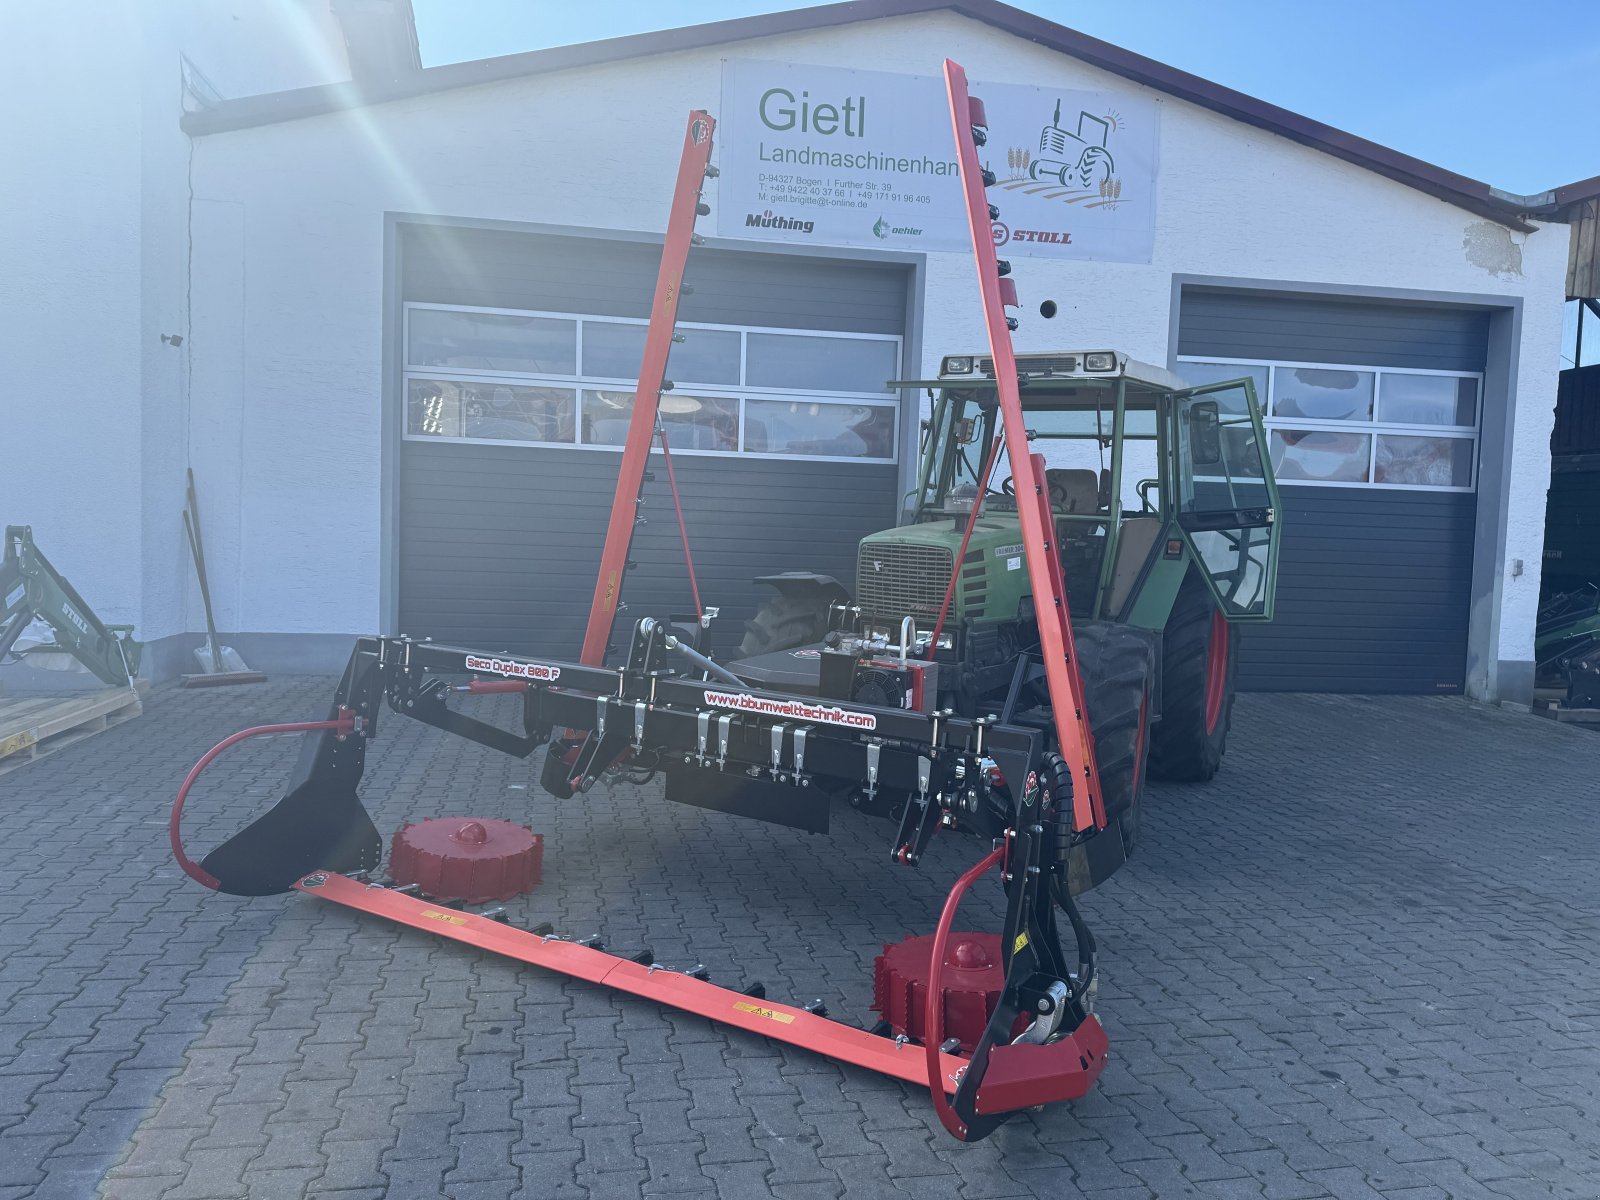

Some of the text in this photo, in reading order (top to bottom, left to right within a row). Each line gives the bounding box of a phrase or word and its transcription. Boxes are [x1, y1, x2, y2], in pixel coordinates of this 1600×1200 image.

[759, 88, 865, 137] Gietl
[759, 173, 793, 183] D-94327
[796, 176, 822, 186] Bogen
[834, 179, 863, 189] Further
[865, 181, 879, 190] Str.
[881, 183, 892, 191] 39
[758, 193, 868, 209] M: gietl.brigitte@t-online.de
[759, 183, 767, 191] T:
[770, 185, 785, 193] +49
[787, 185, 808, 194] 9422
[810, 187, 820, 195] 40
[822, 188, 832, 196] 37
[834, 189, 845, 197] 66
[857, 191, 872, 199] +49
[875, 192, 889, 200] 171
[891, 193, 901, 201] 91
[903, 194, 914, 203] 96
[916, 195, 931, 204] 405
[745, 209, 815, 234] Müthing
[891, 226, 923, 236] oehler
[1012, 230, 1072, 245] STOLL
[467, 657, 491, 670] Seco
[492, 661, 526, 675] Duplex
[551, 669, 559, 679] F
[706, 692, 875, 728] www.bbumwelttechnik.com
